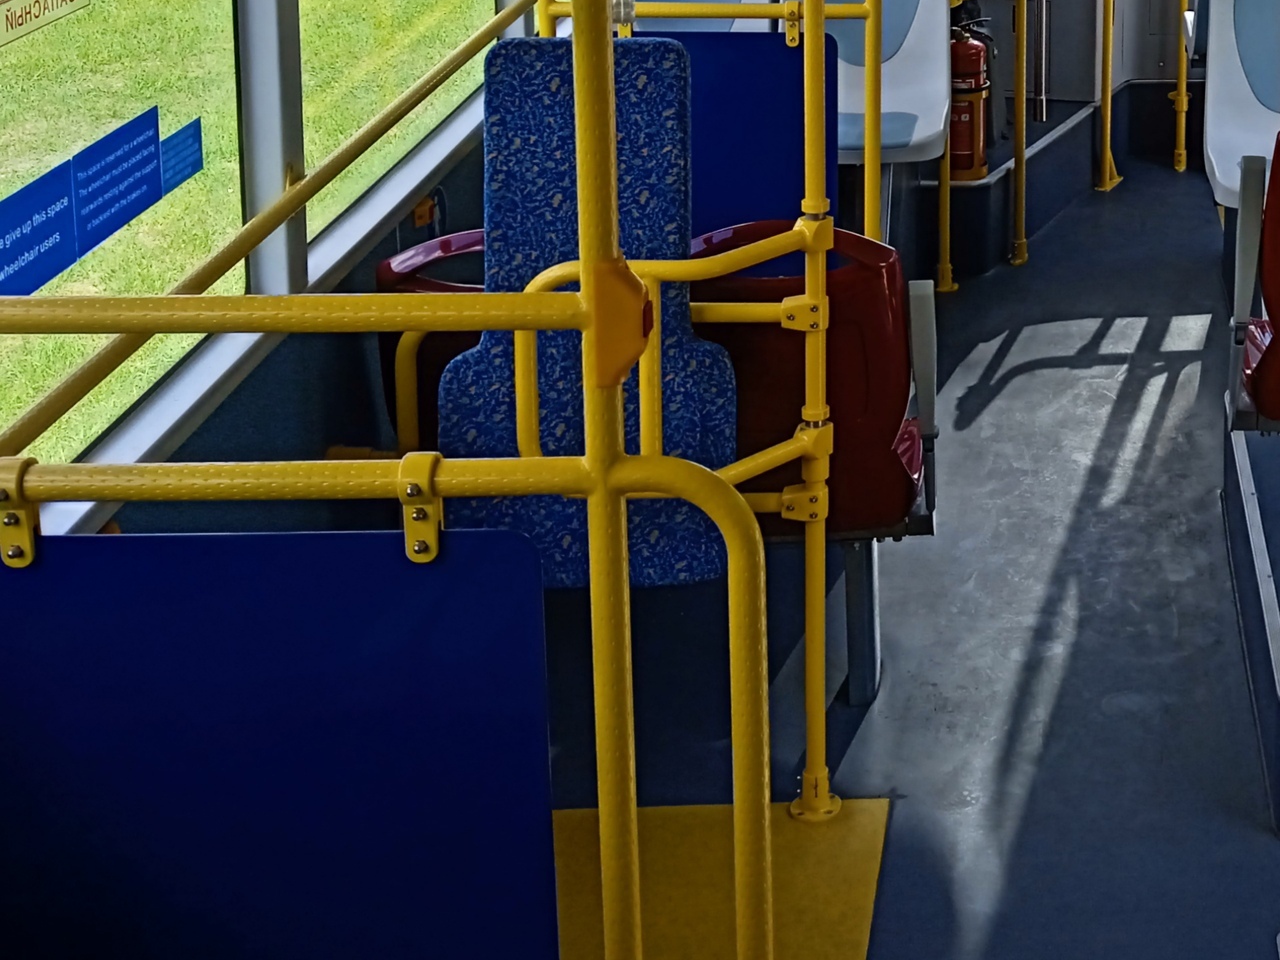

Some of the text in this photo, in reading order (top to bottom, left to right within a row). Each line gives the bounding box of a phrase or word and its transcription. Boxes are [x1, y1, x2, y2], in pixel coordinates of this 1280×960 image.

[5, 227, 21, 248] give
[22, 220, 33, 234] up
[32, 210, 47, 227] this
[47, 196, 69, 218] space
[40, 232, 61, 253] users
